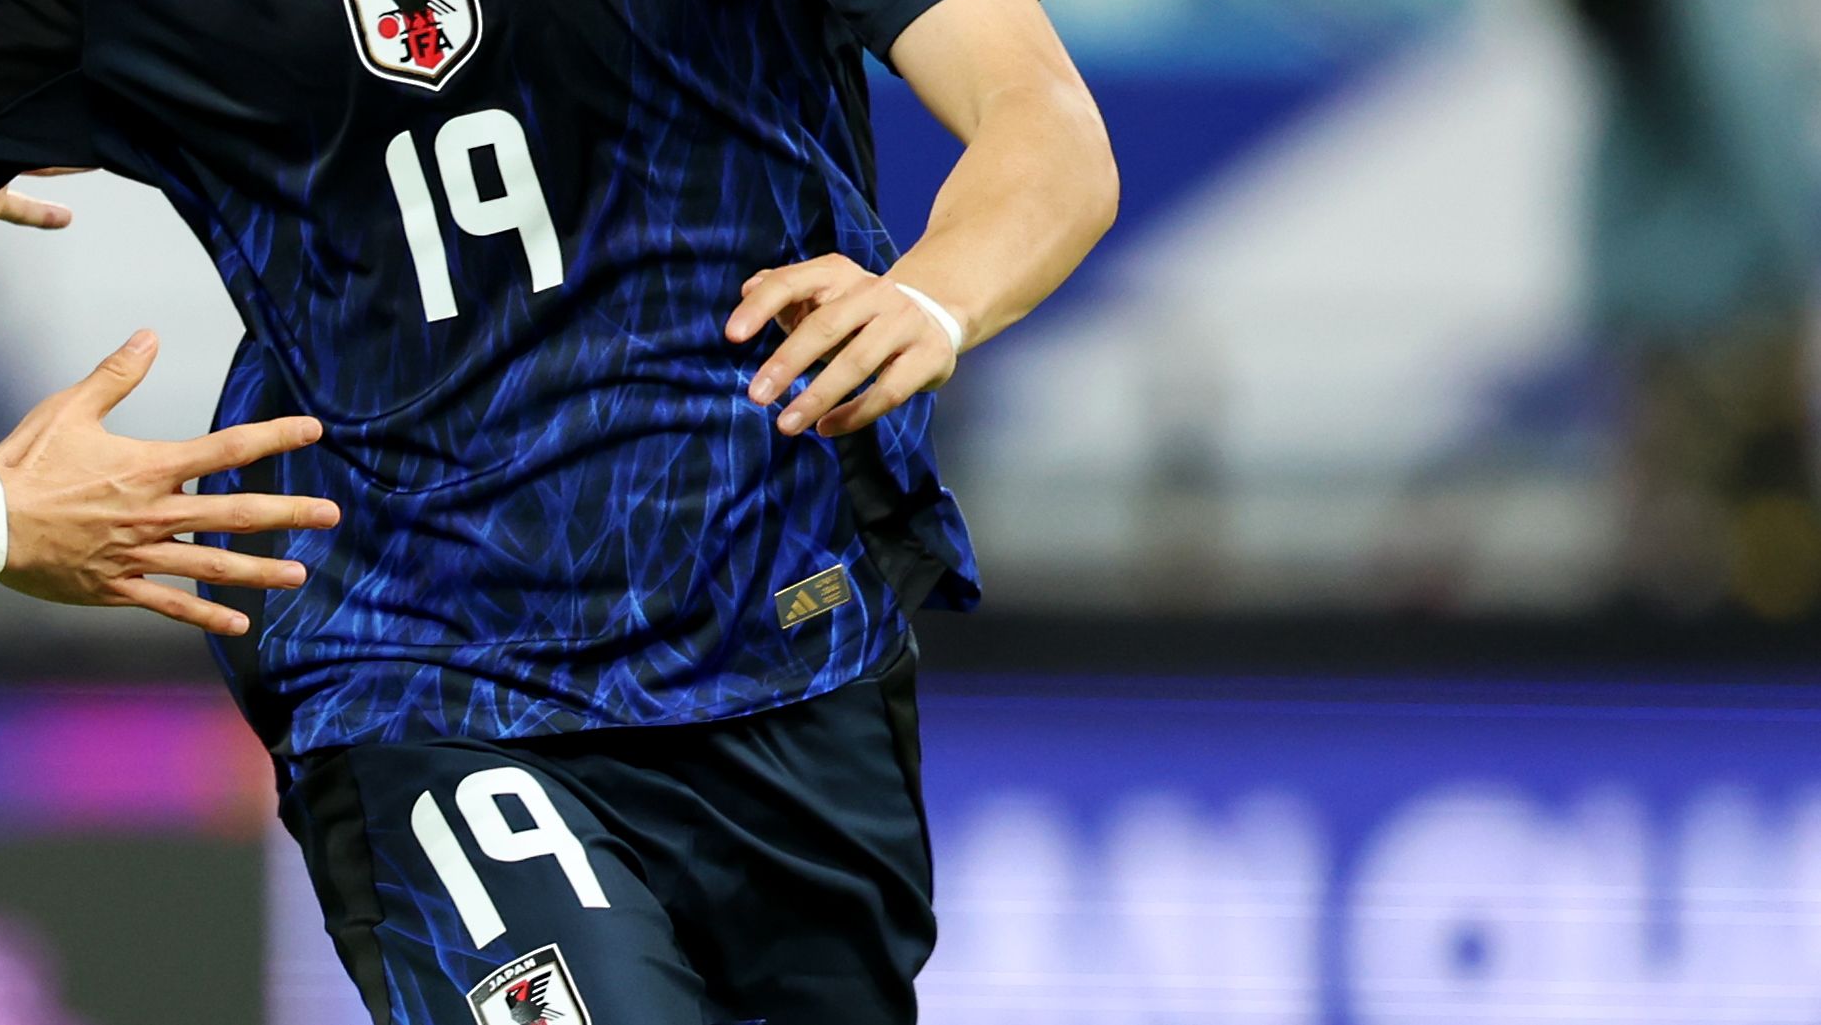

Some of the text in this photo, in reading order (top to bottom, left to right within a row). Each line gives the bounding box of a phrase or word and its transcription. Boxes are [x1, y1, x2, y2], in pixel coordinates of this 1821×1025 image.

[400, 28, 454, 63] JFA
[385, 108, 564, 323] 19
[411, 766, 611, 950] 19
[488, 957, 537, 993] JAPAN
